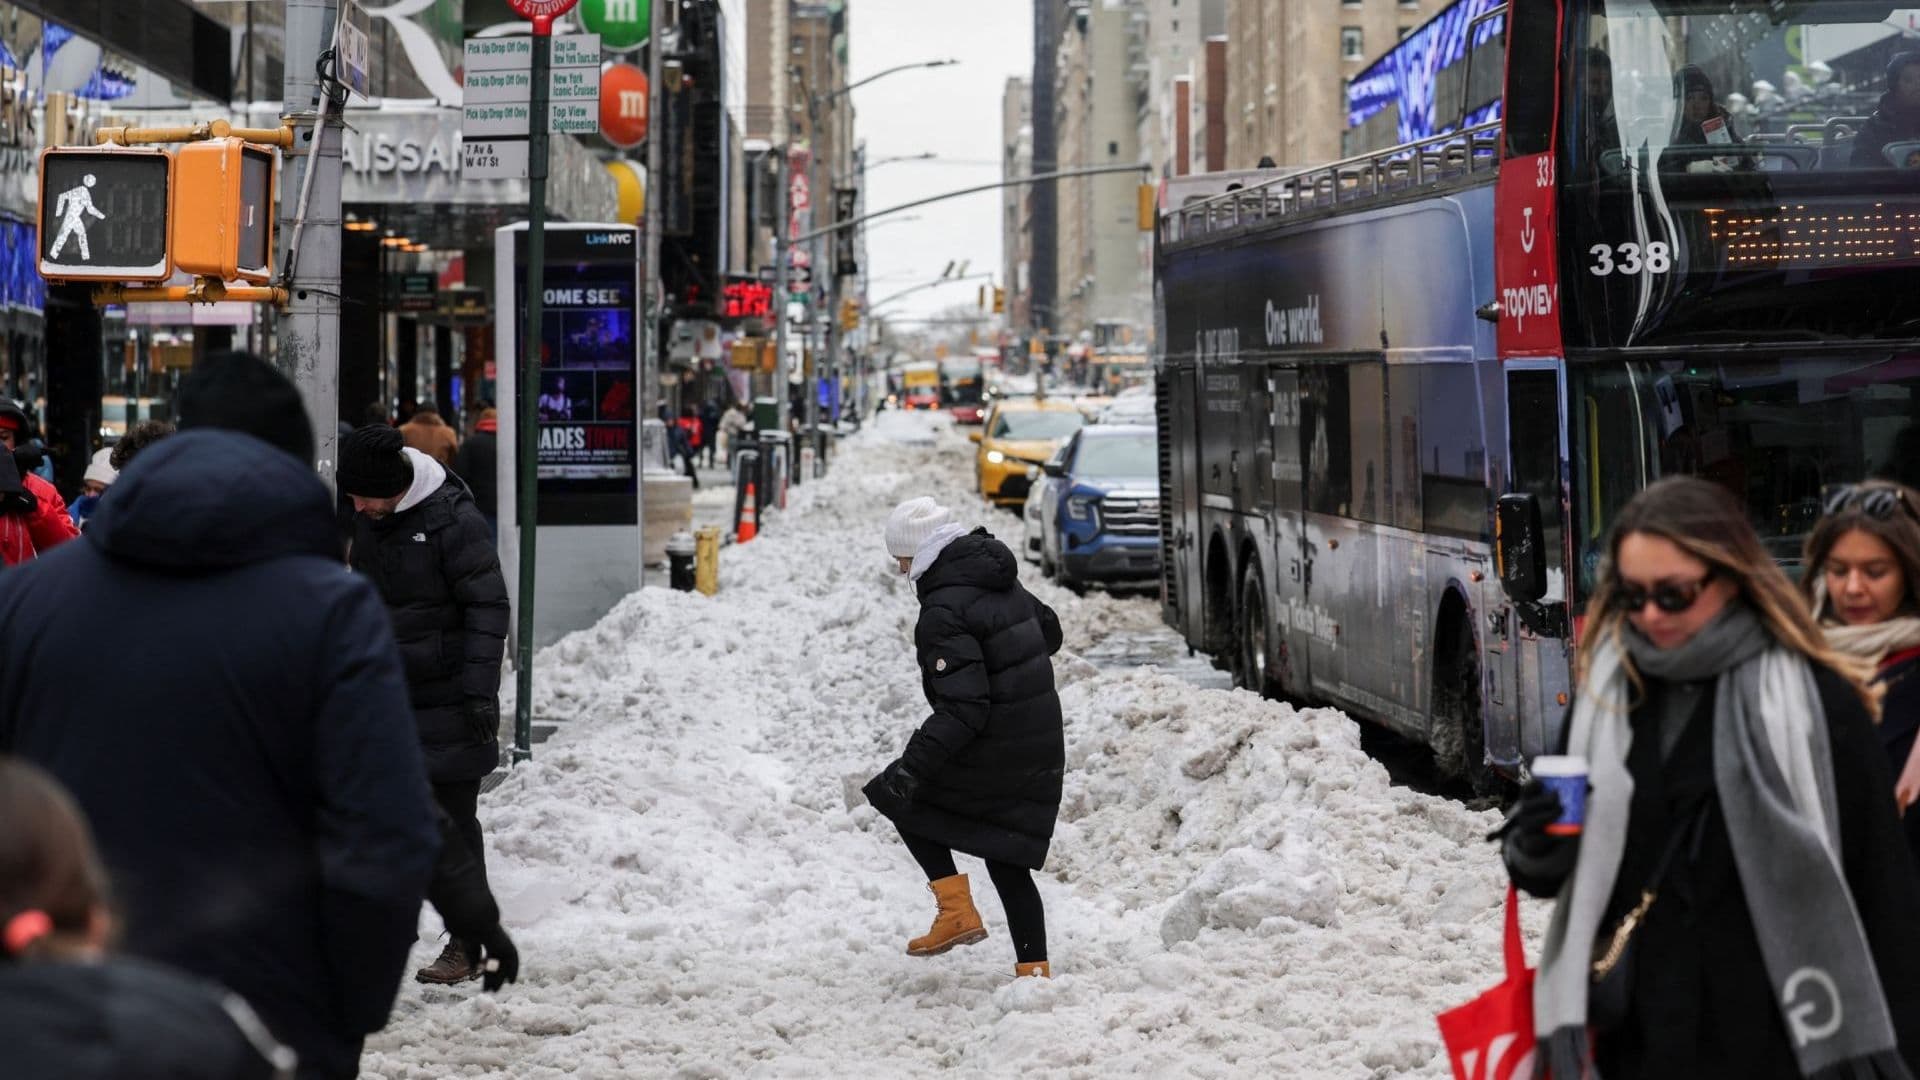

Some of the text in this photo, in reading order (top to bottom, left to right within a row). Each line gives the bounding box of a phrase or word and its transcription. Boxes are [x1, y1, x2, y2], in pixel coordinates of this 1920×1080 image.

[604, 0, 637, 22] m
[468, 43, 480, 54] Pick
[507, 41, 515, 53] Off
[517, 41, 529, 54] Only
[555, 41, 565, 52] Gray
[554, 54, 564, 64] New
[566, 53, 576, 64] York
[467, 76, 479, 87] Pick
[506, 75, 514, 86] Off
[516, 75, 528, 87] Only
[554, 72, 583, 84] New York
[553, 84, 597, 96] Iconic Cruises
[619, 91, 645, 118] m
[466, 109, 478, 120] Pick
[505, 107, 513, 119] Off
[514, 107, 527, 119] Only
[552, 105, 586, 118] Top View
[552, 119, 597, 131] Sightseeing
[466, 144, 493, 154] 7 Av &
[466, 156, 499, 167] W 47 St
[586, 234, 631, 244] LinkNYC
[1589, 241, 1670, 276] 338
[544, 289, 619, 304] OME SEE
[1265, 294, 1323, 346] One world.
